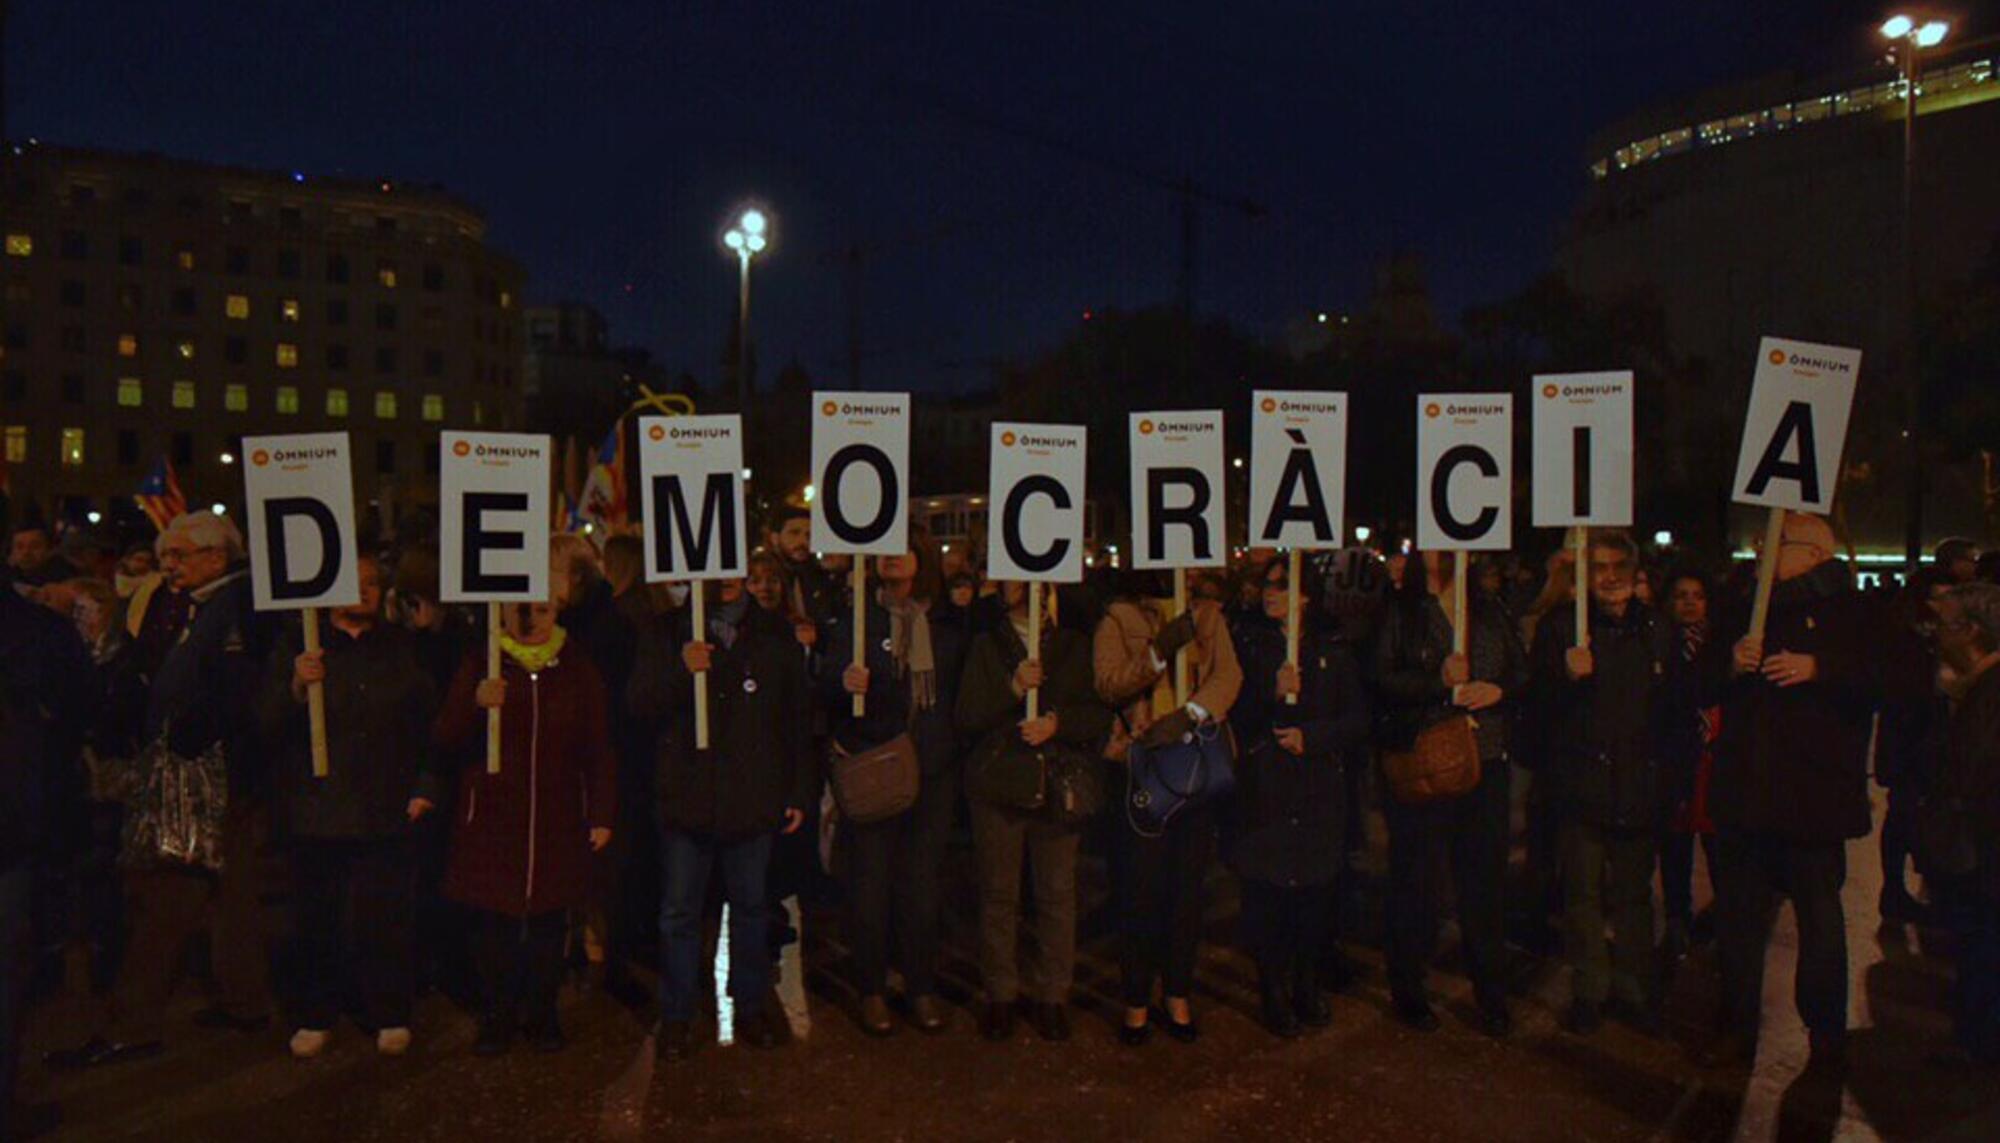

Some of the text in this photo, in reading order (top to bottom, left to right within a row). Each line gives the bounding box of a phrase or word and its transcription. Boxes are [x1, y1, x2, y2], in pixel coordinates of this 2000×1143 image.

[823, 445, 897, 543] O
[1263, 430, 1333, 540] À
[1432, 445, 1498, 540] C
[1574, 427, 1590, 516] I
[1745, 401, 1820, 503] A
[264, 498, 341, 600] D
[462, 493, 529, 592] E
[653, 474, 736, 572] M
[1003, 476, 1071, 571] C
[1148, 468, 1211, 559] R
